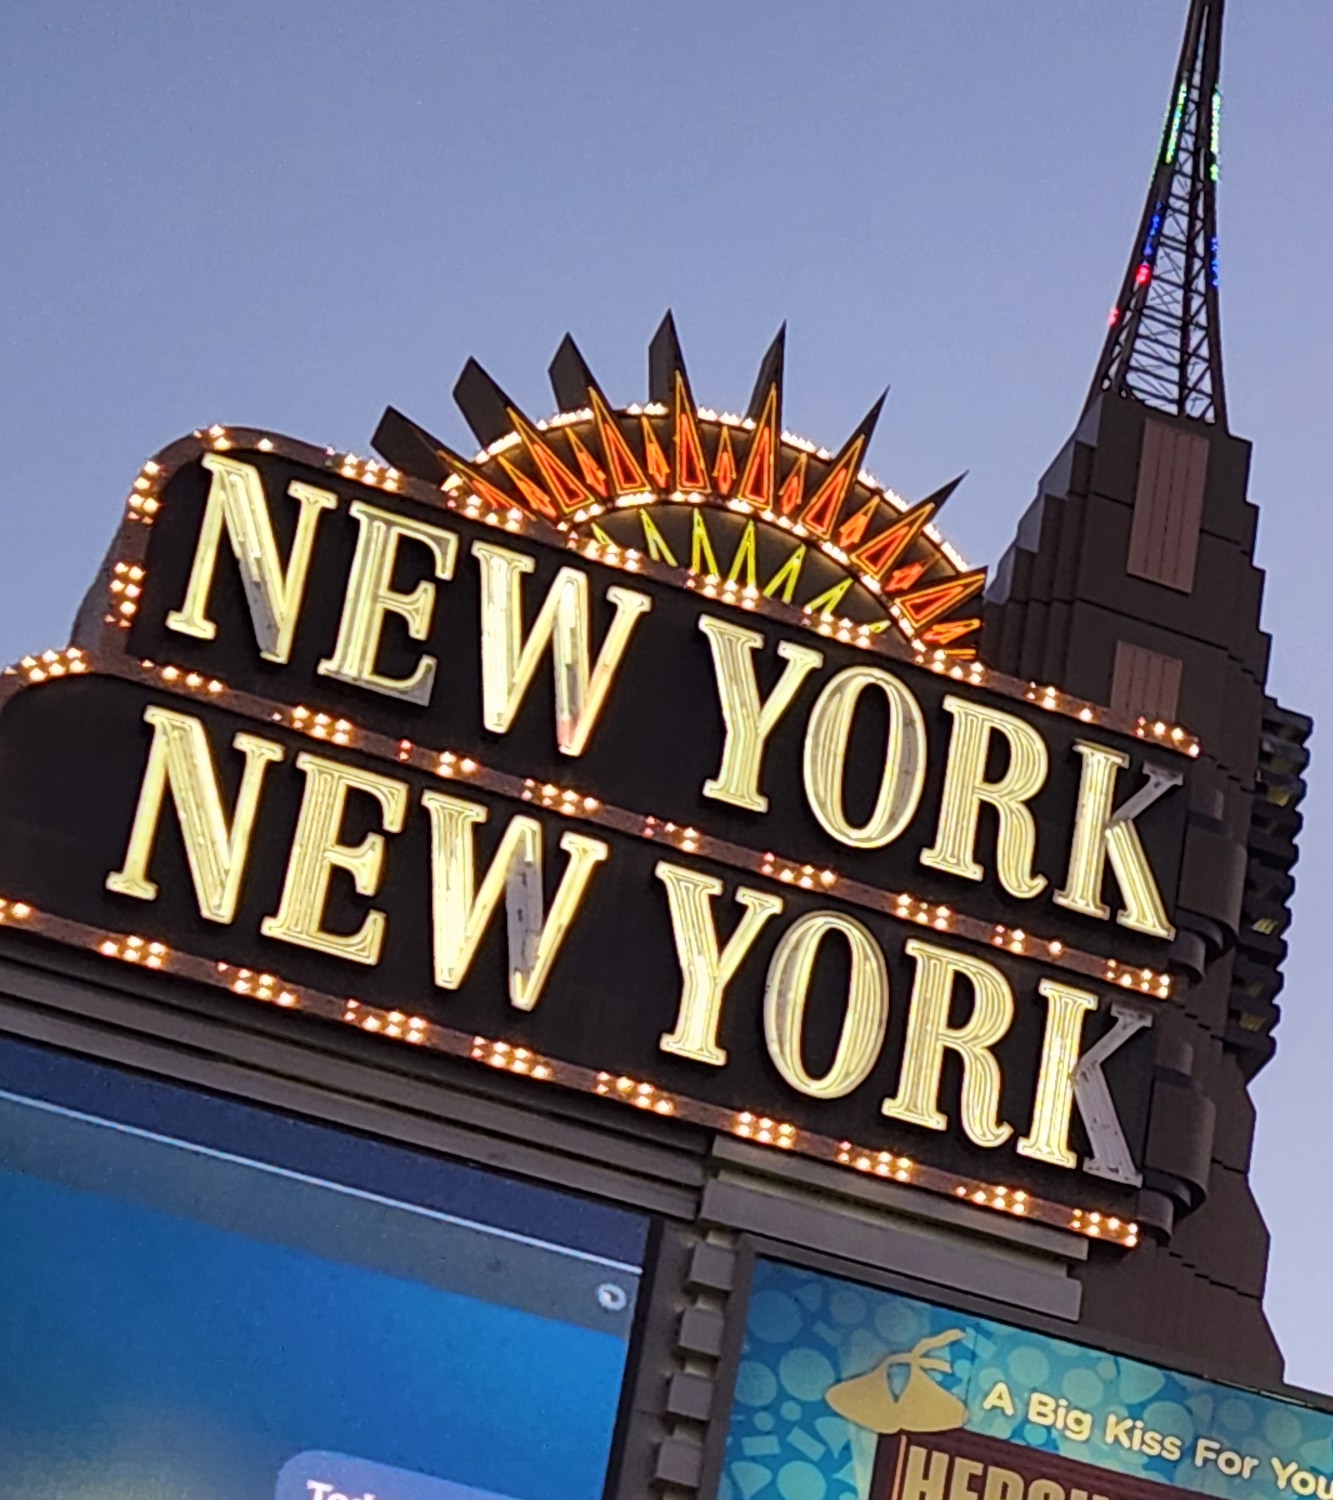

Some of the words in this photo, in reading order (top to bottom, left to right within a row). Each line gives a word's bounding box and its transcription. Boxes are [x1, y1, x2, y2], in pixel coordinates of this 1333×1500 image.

[165, 450, 652, 757] NEW
[696, 613, 1185, 941] YORK
[104, 704, 607, 1012] NEW
[654, 861, 1154, 1188] YORK
[982, 1381, 1015, 1417] A
[1027, 1391, 1093, 1442] Big
[1104, 1413, 1184, 1462] Kiss
[1194, 1438, 1260, 1480] For
